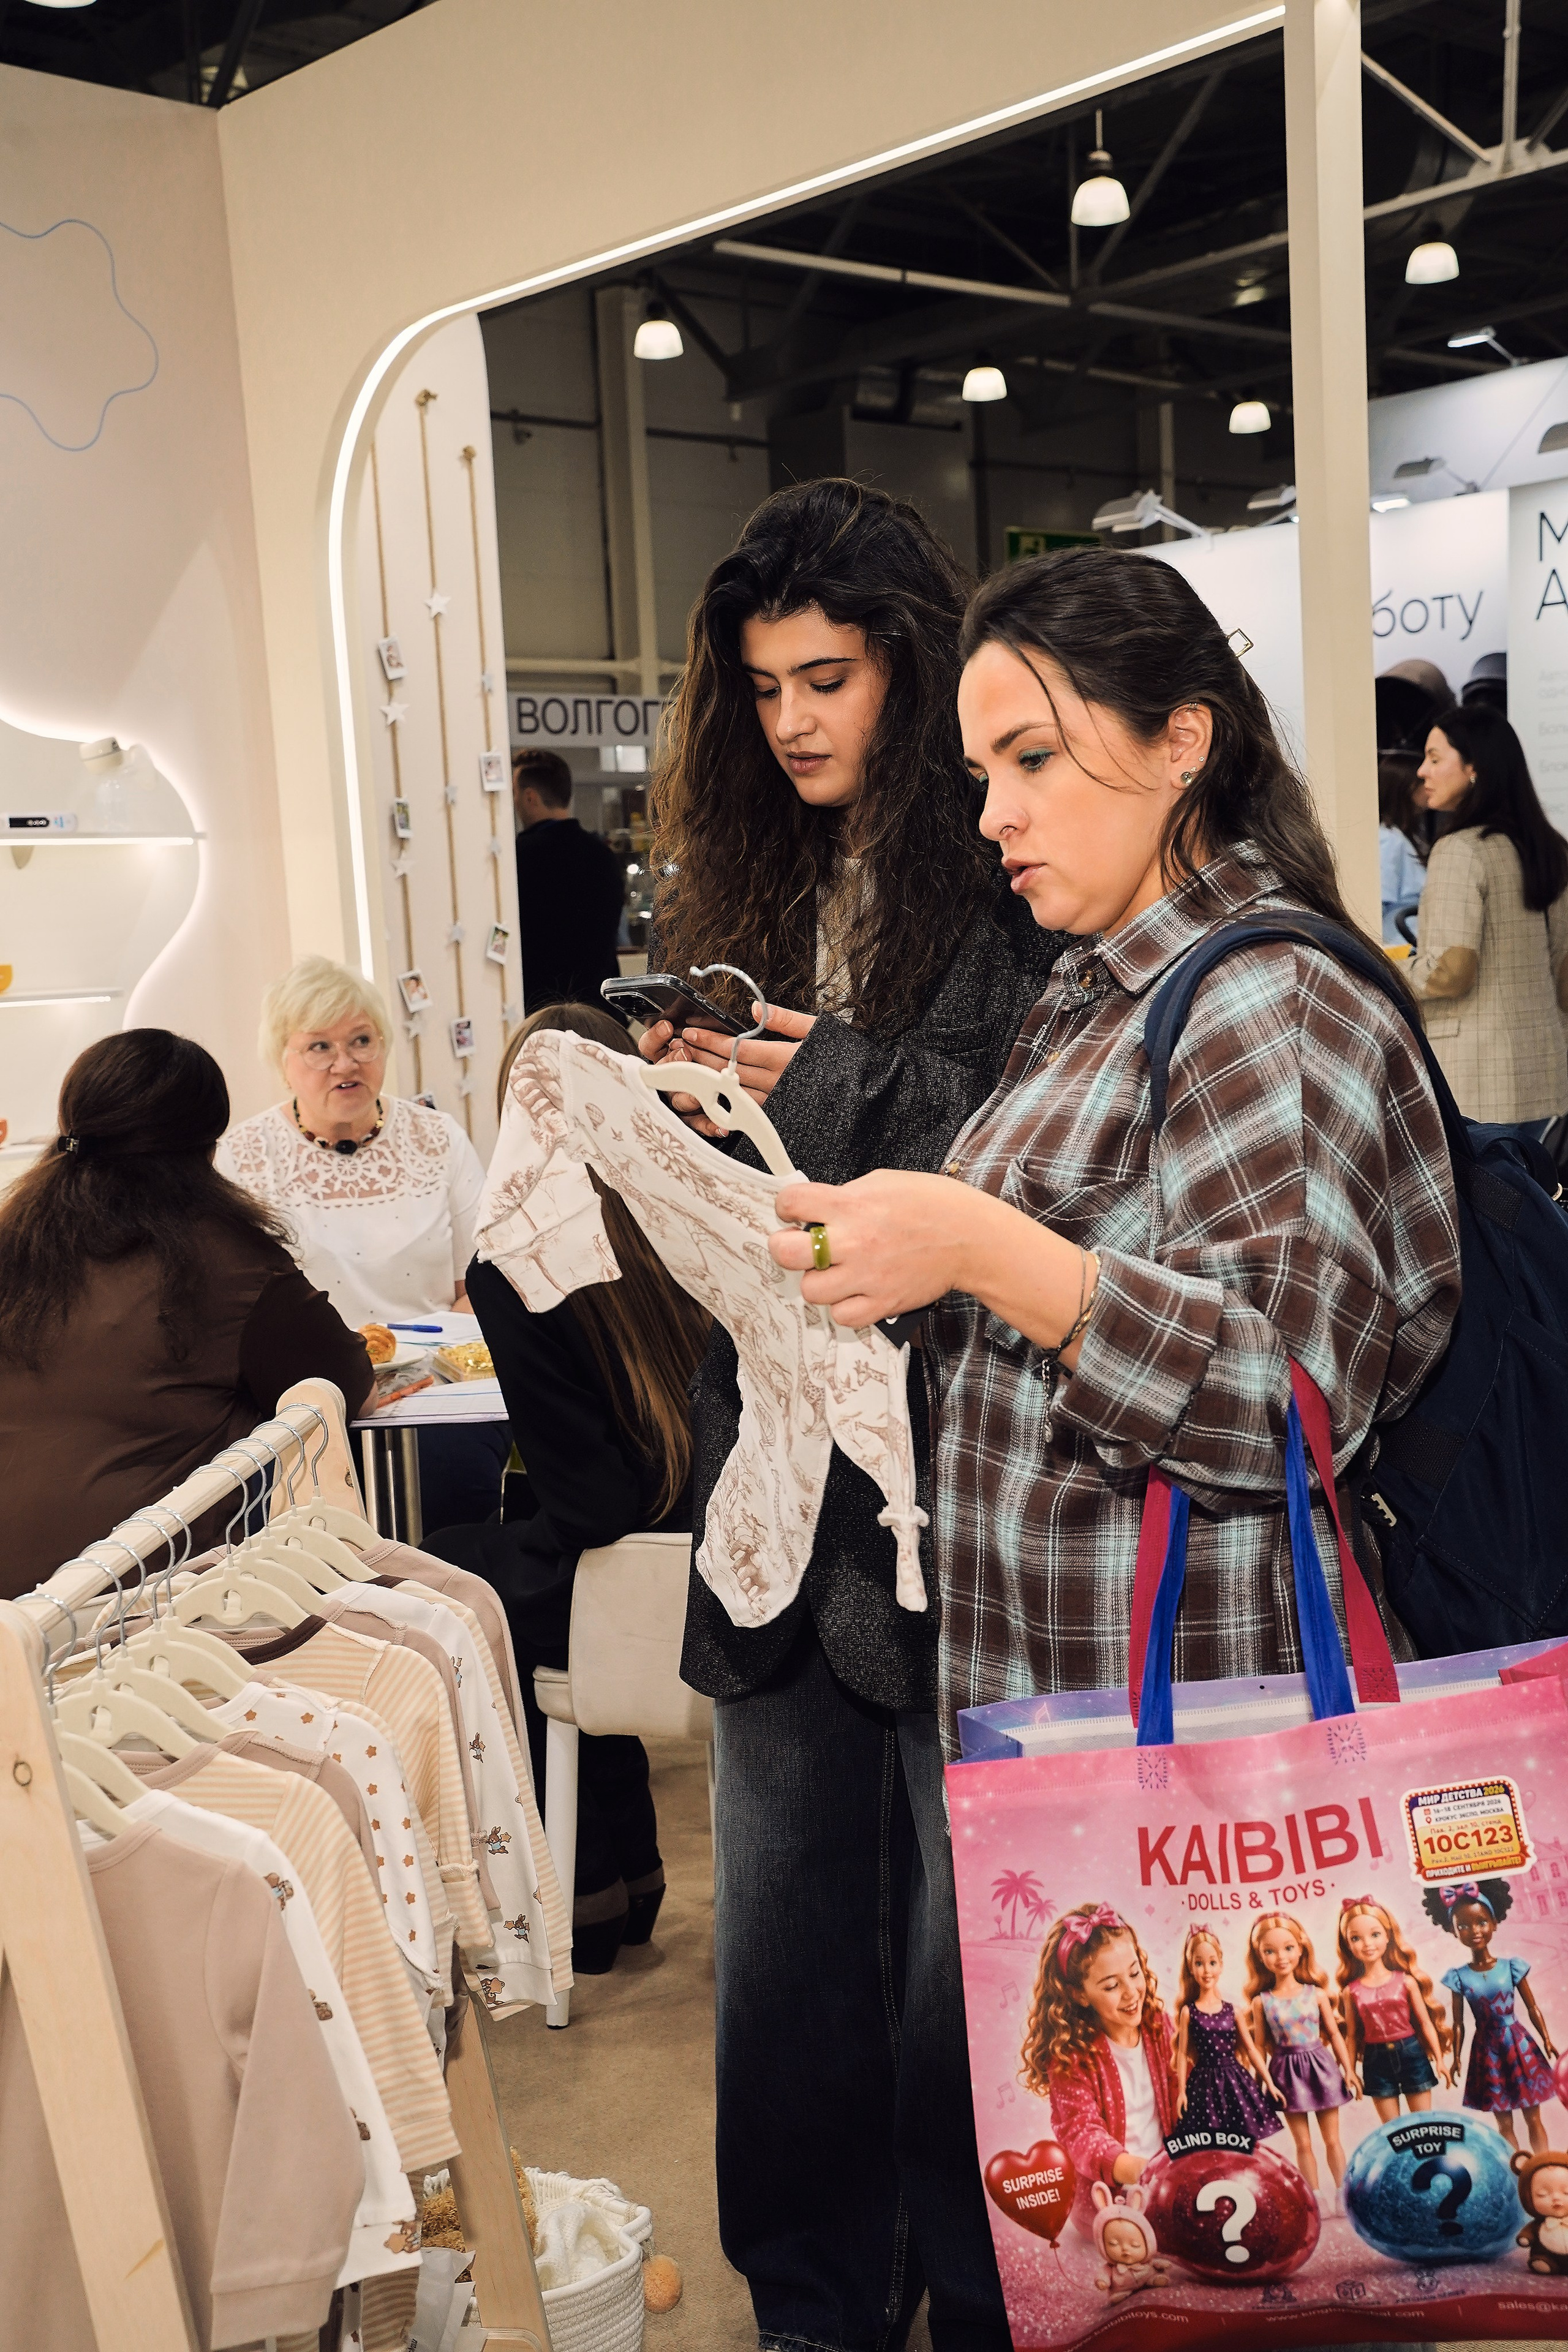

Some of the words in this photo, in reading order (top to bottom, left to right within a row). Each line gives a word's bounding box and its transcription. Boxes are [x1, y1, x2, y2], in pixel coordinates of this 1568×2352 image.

[516, 696, 677, 736] ВОЛГОГ
[1418, 1794, 1440, 1806] МИР
[1441, 1788, 1483, 1803] ДЕТСТВА
[1483, 1785, 1505, 1796] 2026
[1480, 1807, 1504, 1815] МОСКВА
[1137, 1797, 1383, 1886] KAIBIBI
[1423, 1825, 1513, 1855] 10C123
[1189, 1892, 1242, 1911] DOLLS
[1249, 1891, 1264, 1909] &
[1269, 1879, 1326, 1906] TOYS
[1166, 2132, 1212, 2155] BLIND
[1215, 2132, 1251, 2150] BOX
[1392, 2125, 1462, 2147] SURPRISE
[1415, 2142, 1442, 2155] TOY
[1002, 2166, 1065, 2195] SURPRISE
[1016, 2188, 1060, 2210] INSIDE!
